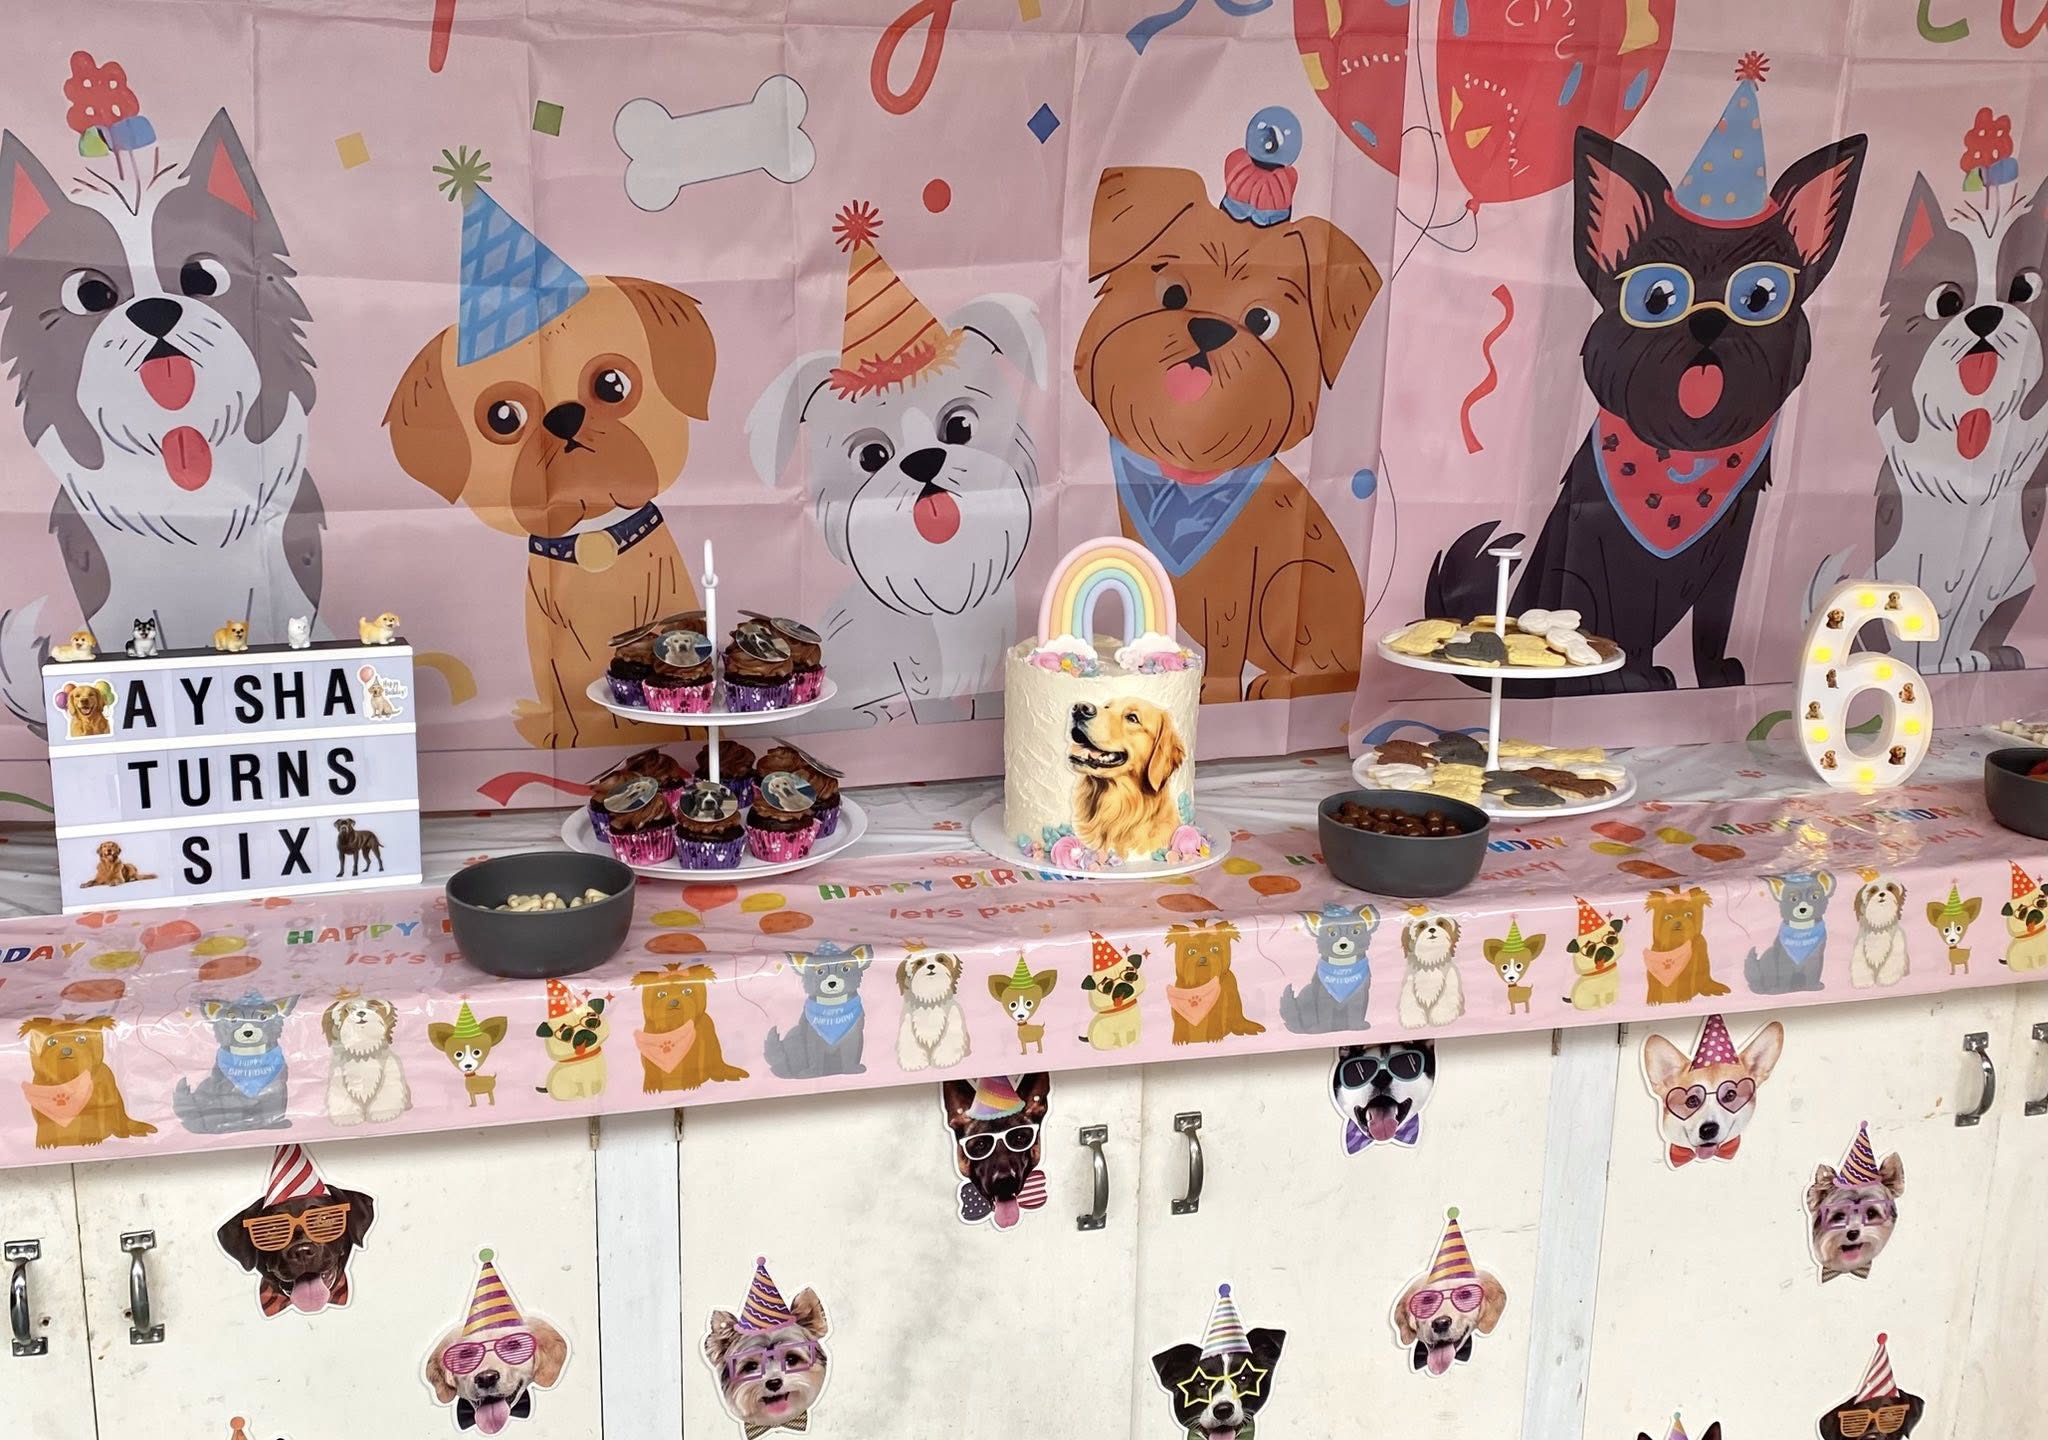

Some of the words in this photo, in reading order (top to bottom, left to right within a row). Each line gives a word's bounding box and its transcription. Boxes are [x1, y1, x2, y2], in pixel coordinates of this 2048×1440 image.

[122, 668, 356, 730] AYSHA
[1793, 579, 1940, 789] 6
[127, 747, 357, 809] TURNS
[181, 826, 312, 885] SIX
[819, 880, 933, 900] HAPPY
[287, 921, 420, 945] HAPPY
[889, 907, 964, 920] let's
[344, 952, 427, 965] let's
